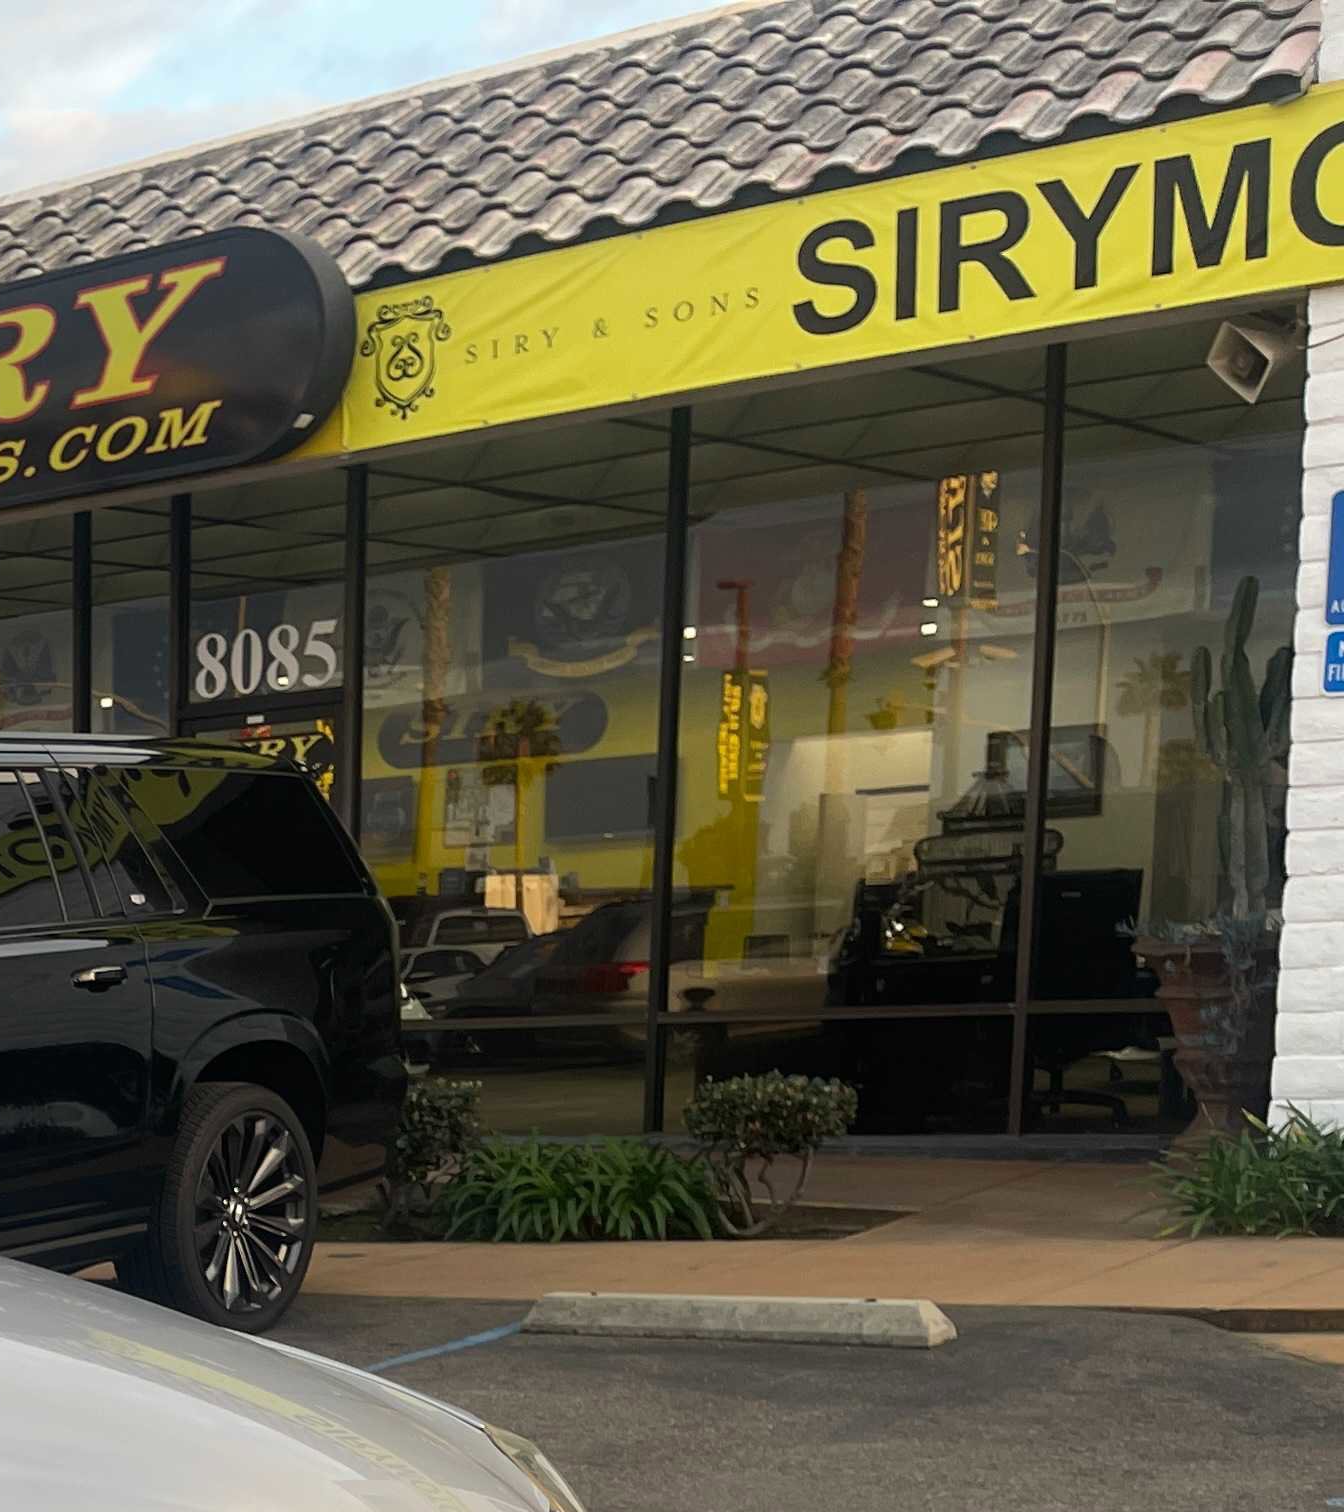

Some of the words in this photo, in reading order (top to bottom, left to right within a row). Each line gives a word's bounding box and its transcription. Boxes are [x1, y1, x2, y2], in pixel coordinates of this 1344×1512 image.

[464, 328, 560, 364] SIRY
[592, 319, 609, 339] &
[644, 287, 760, 329] SONS
[196, 618, 339, 700] 8085
